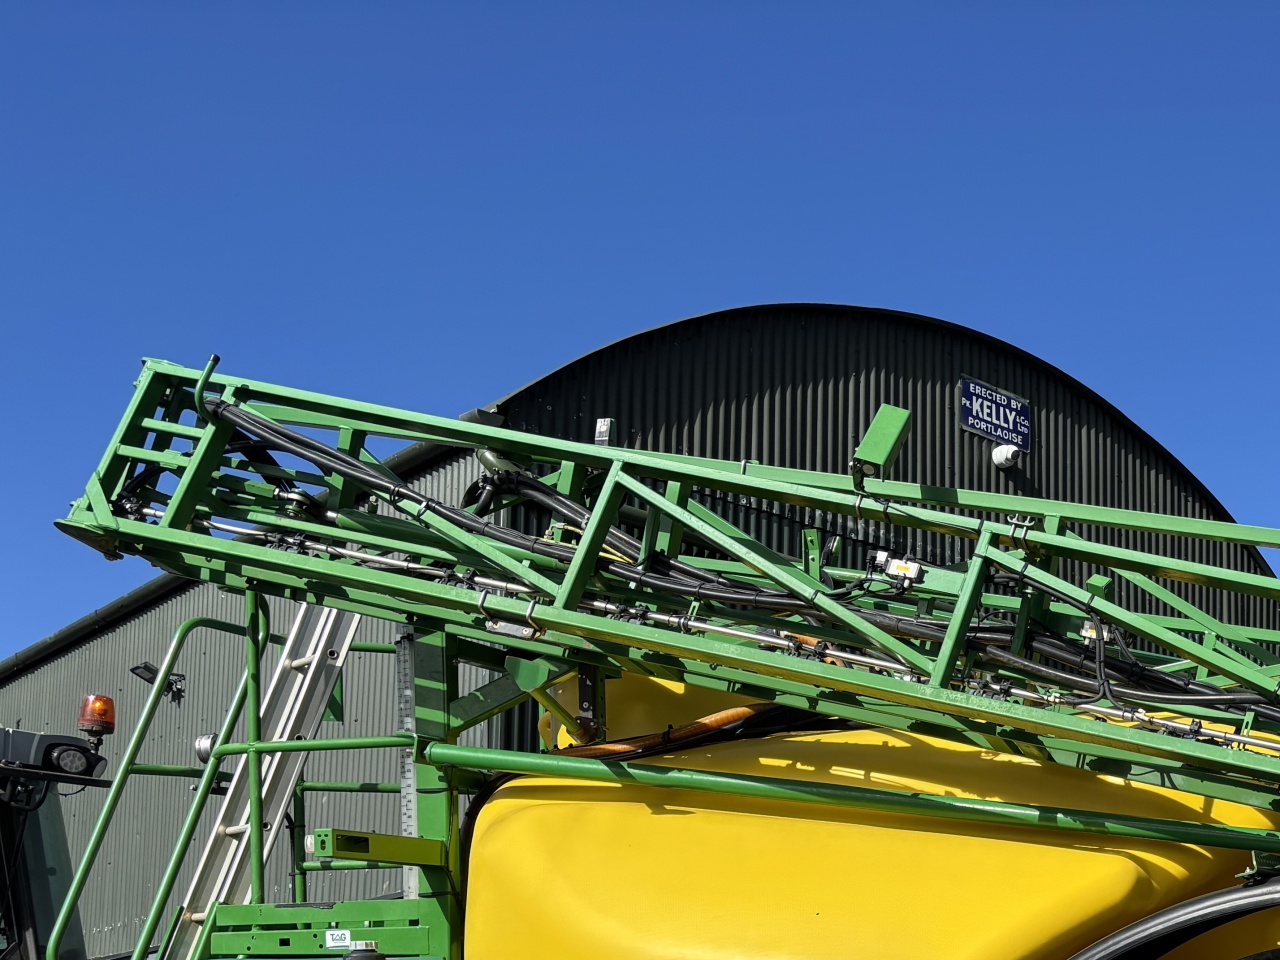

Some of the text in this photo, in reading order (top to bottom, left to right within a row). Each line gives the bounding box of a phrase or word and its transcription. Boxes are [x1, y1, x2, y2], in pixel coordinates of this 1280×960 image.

[969, 383, 1022, 411] ERECTED BY
[972, 395, 1016, 430] KELLY
[968, 416, 1023, 445] PORTLAOISE
[330, 933, 346, 942] TAG
